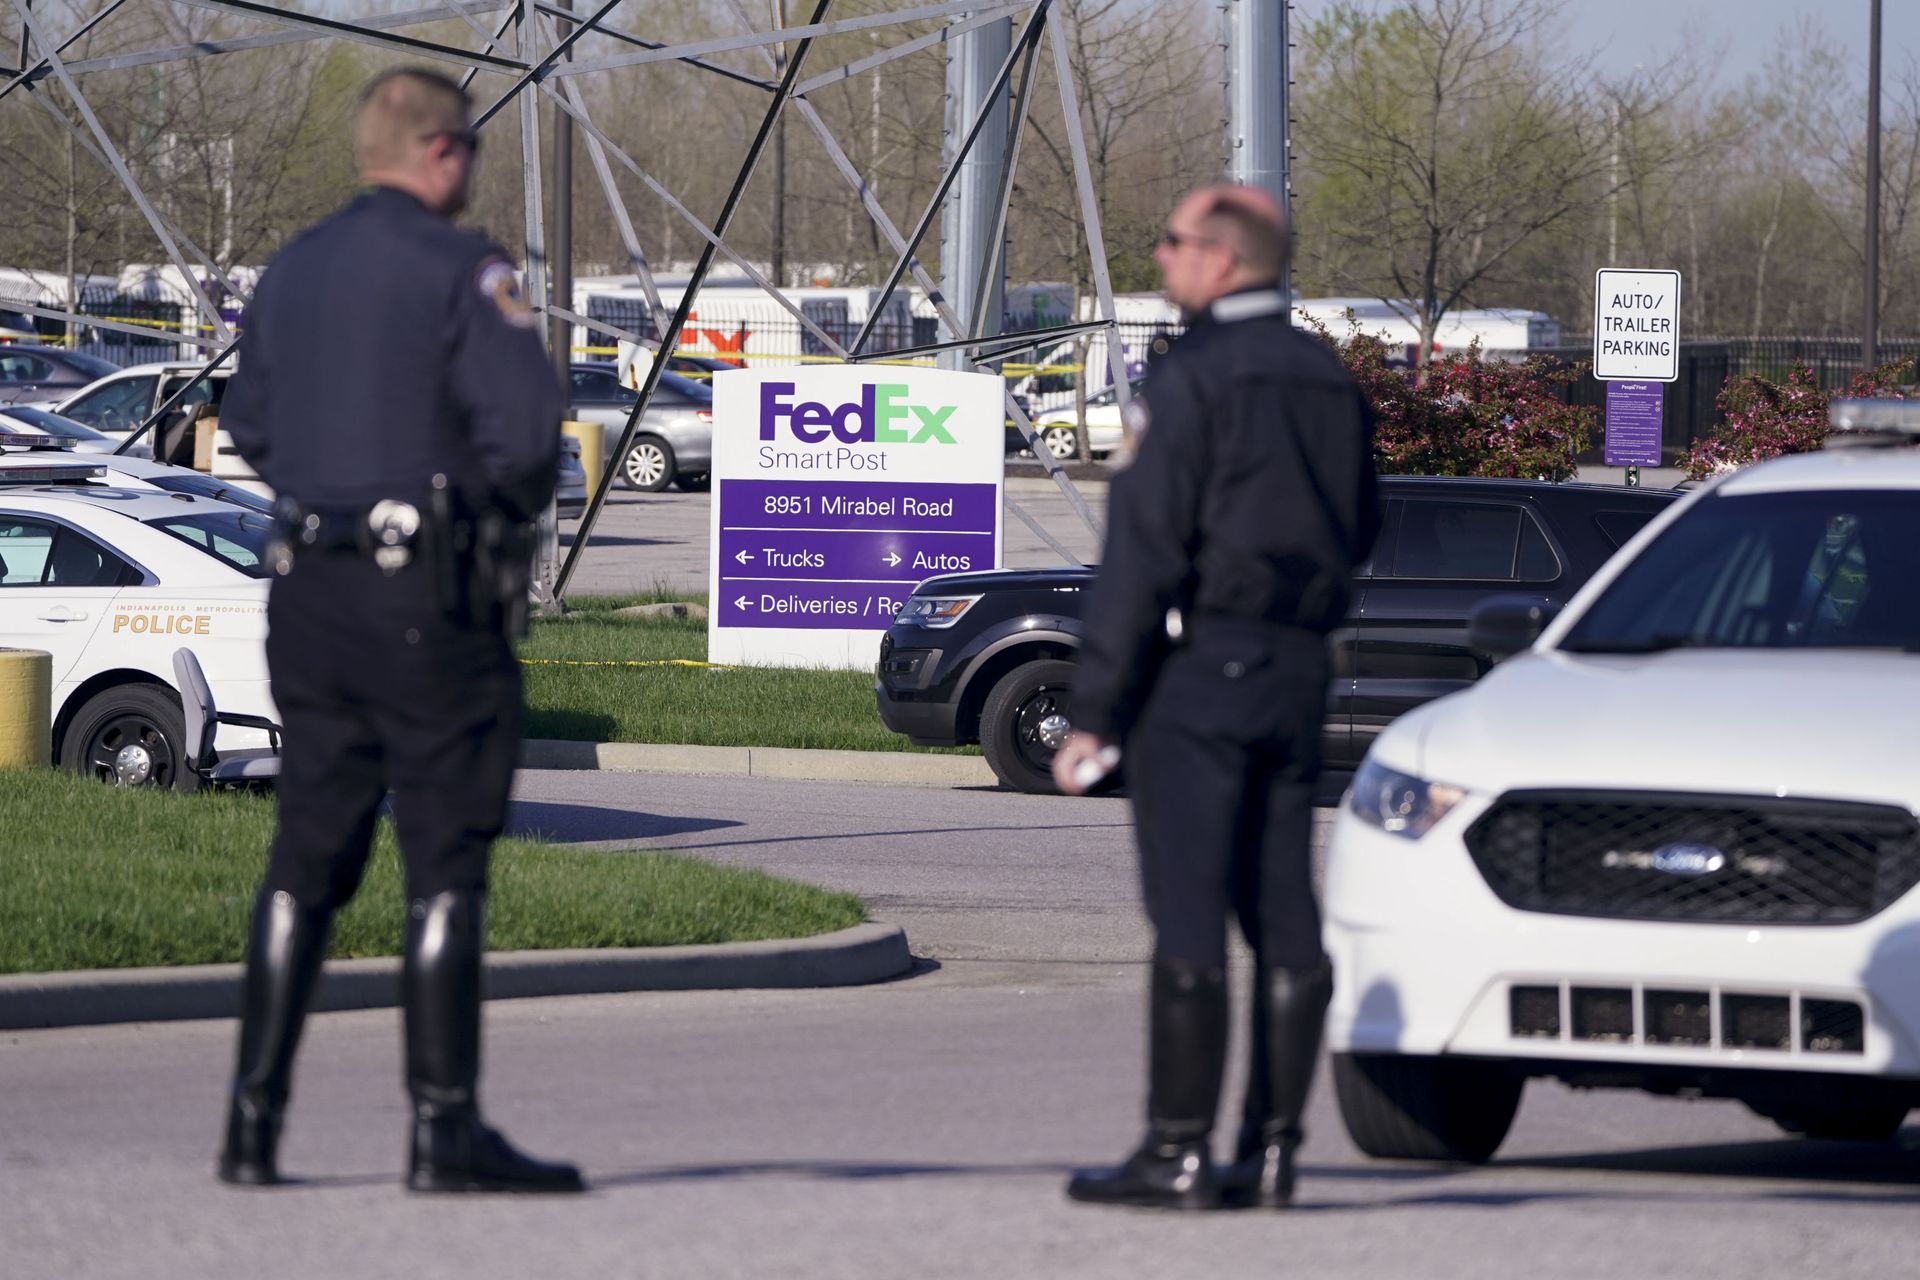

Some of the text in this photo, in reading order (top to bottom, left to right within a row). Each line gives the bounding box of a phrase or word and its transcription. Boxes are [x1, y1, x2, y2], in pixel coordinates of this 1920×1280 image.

[1611, 294, 1664, 310] AUTO/
[1604, 316, 1670, 333] TRAILER
[1603, 340, 1670, 356] PARKING
[759, 382, 958, 443] FedEx
[758, 446, 888, 471] SmartPost
[764, 496, 953, 517] 8951 Mirabel Road
[763, 549, 825, 568] Trucks
[912, 551, 971, 570] Autos
[760, 594, 903, 617] Deliveries / Re
[113, 615, 211, 634] POLICE
